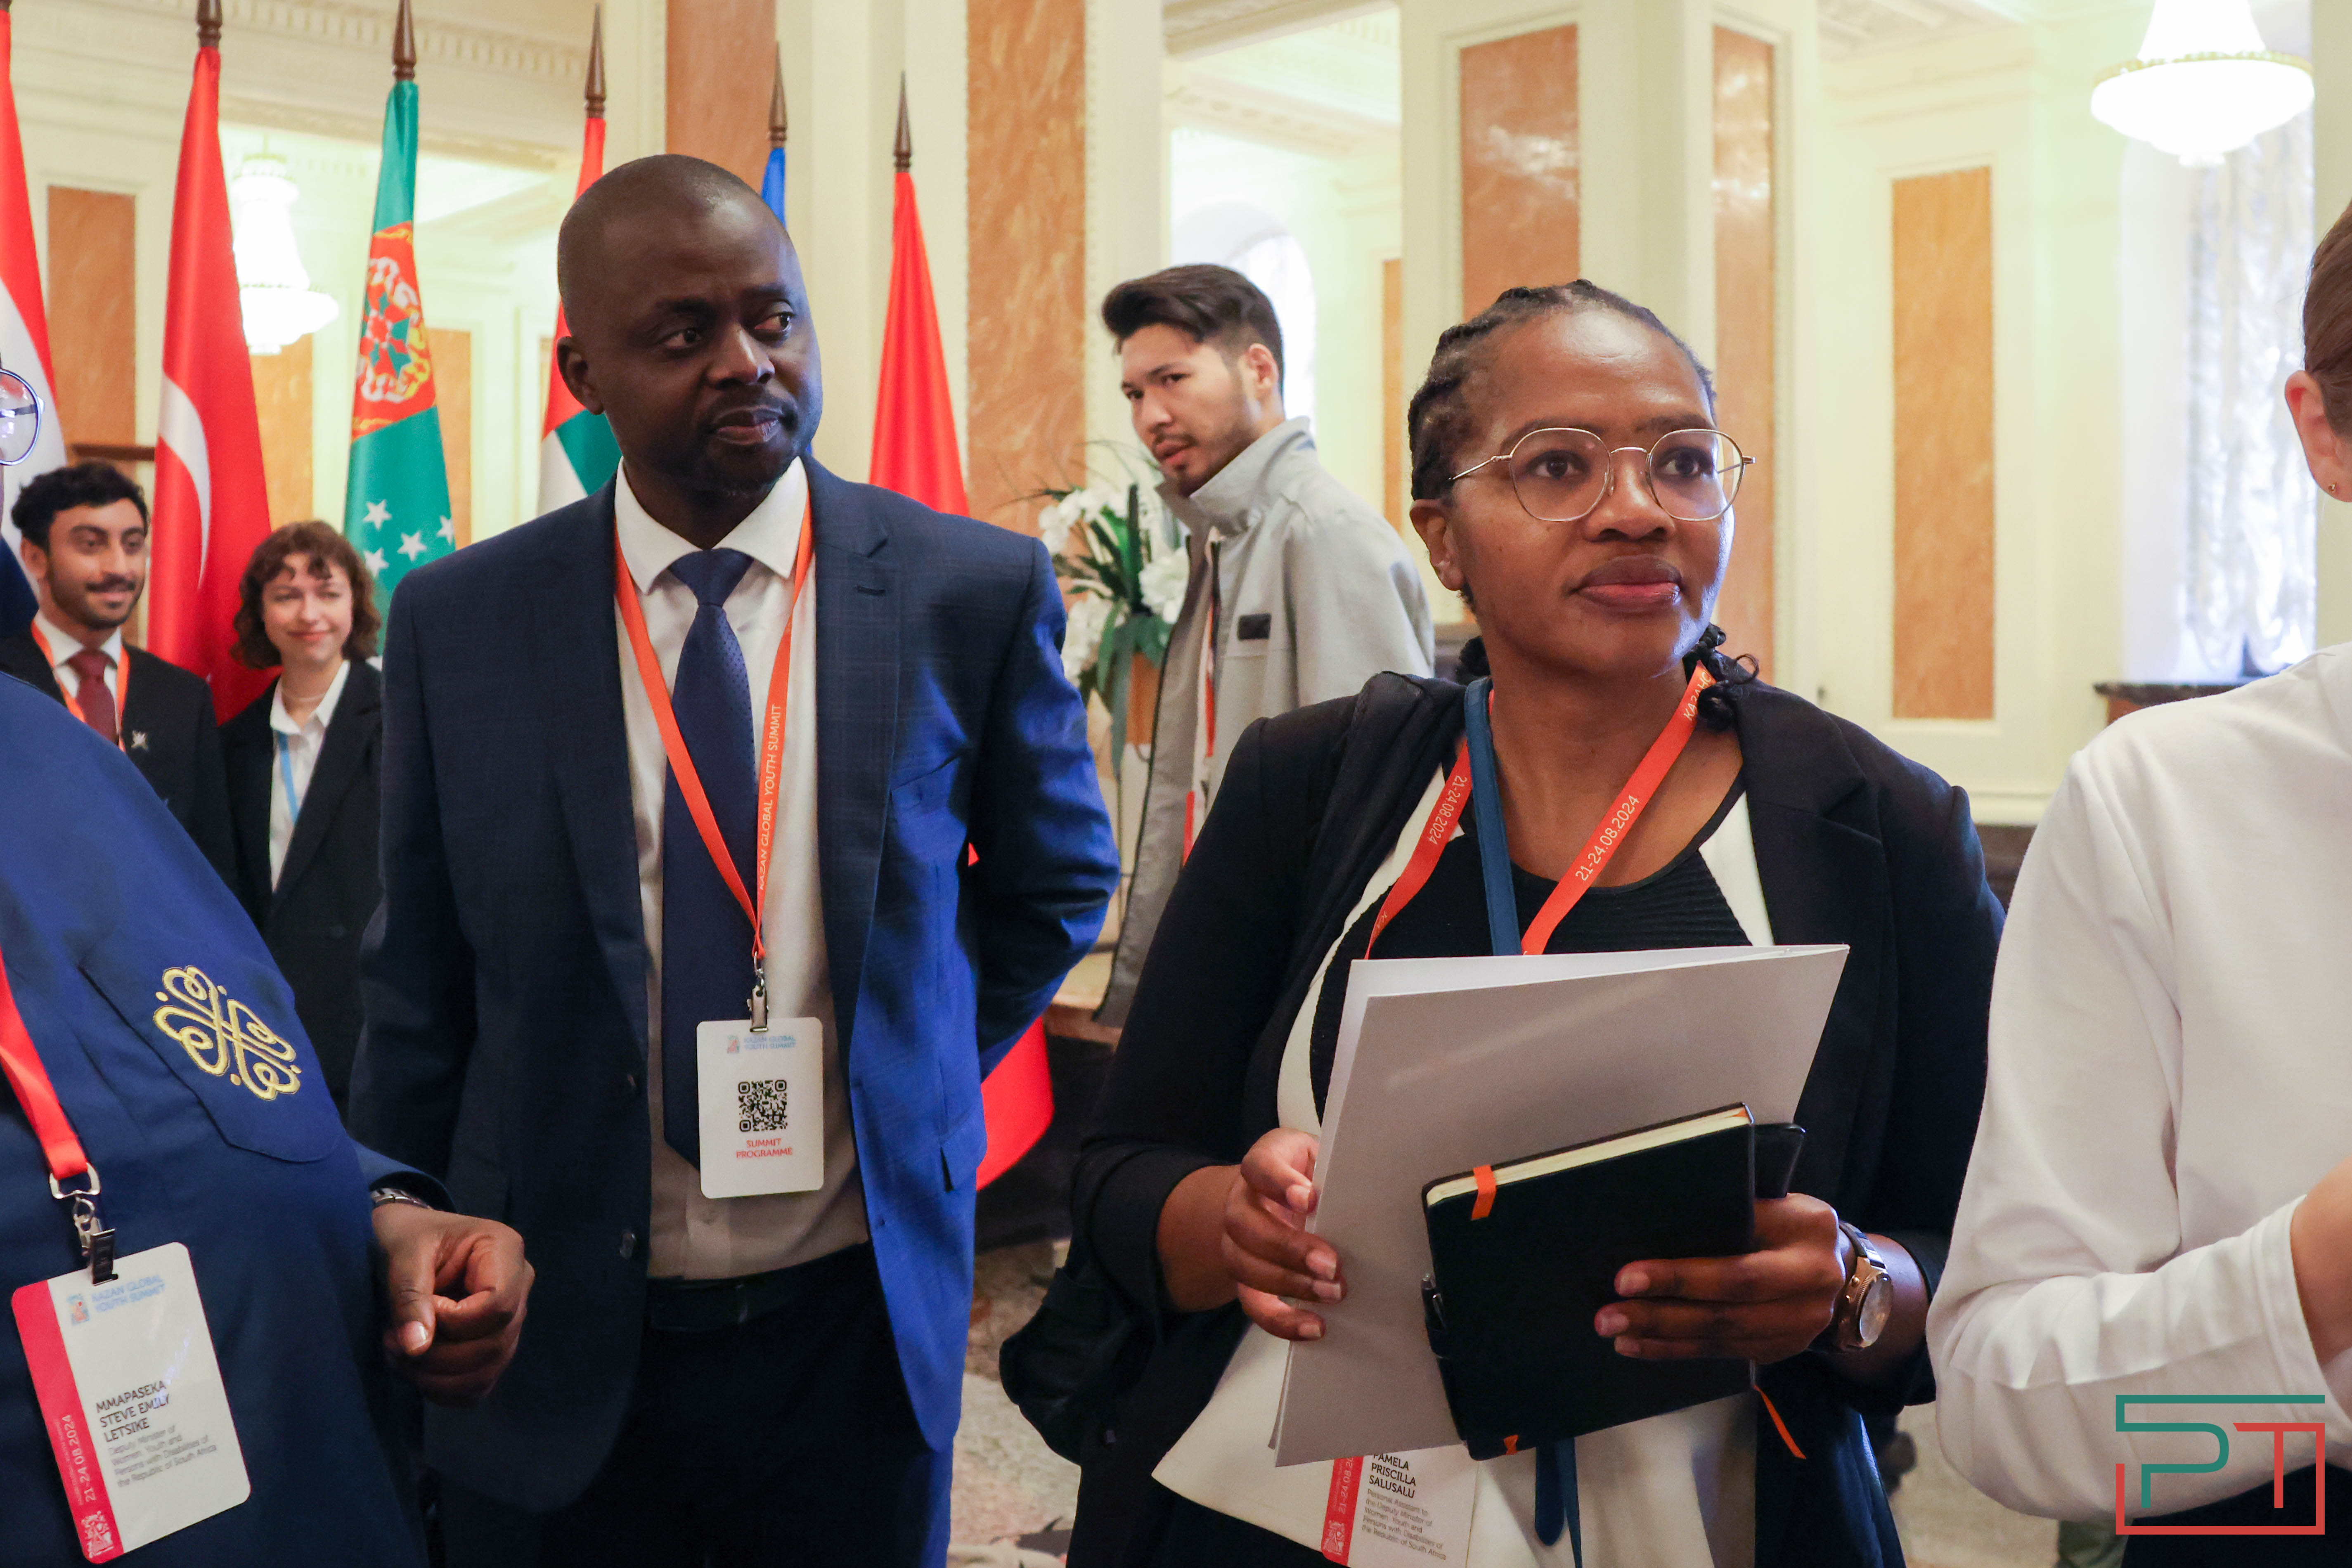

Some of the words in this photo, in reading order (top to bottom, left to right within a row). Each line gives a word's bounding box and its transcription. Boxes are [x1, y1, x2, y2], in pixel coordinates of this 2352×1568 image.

[768, 703, 781, 751] SUMMIT
[764, 754, 776, 795] YOUTH
[761, 799, 773, 846] GLOBAL
[1429, 776, 1467, 845] 21-24.08.2024
[1575, 795, 1639, 881] 21-24.08.2024
[736, 1147, 793, 1159] PROGRAMME
[746, 1138, 782, 1148] SUMMIT
[96, 1381, 166, 1413] MMAPASEKA
[100, 1407, 136, 1427] STEVE
[104, 1418, 149, 1442] LETSIKE
[1369, 1475, 1415, 1498] SALUSALU
[1371, 1462, 1416, 1486] PRISCILLA
